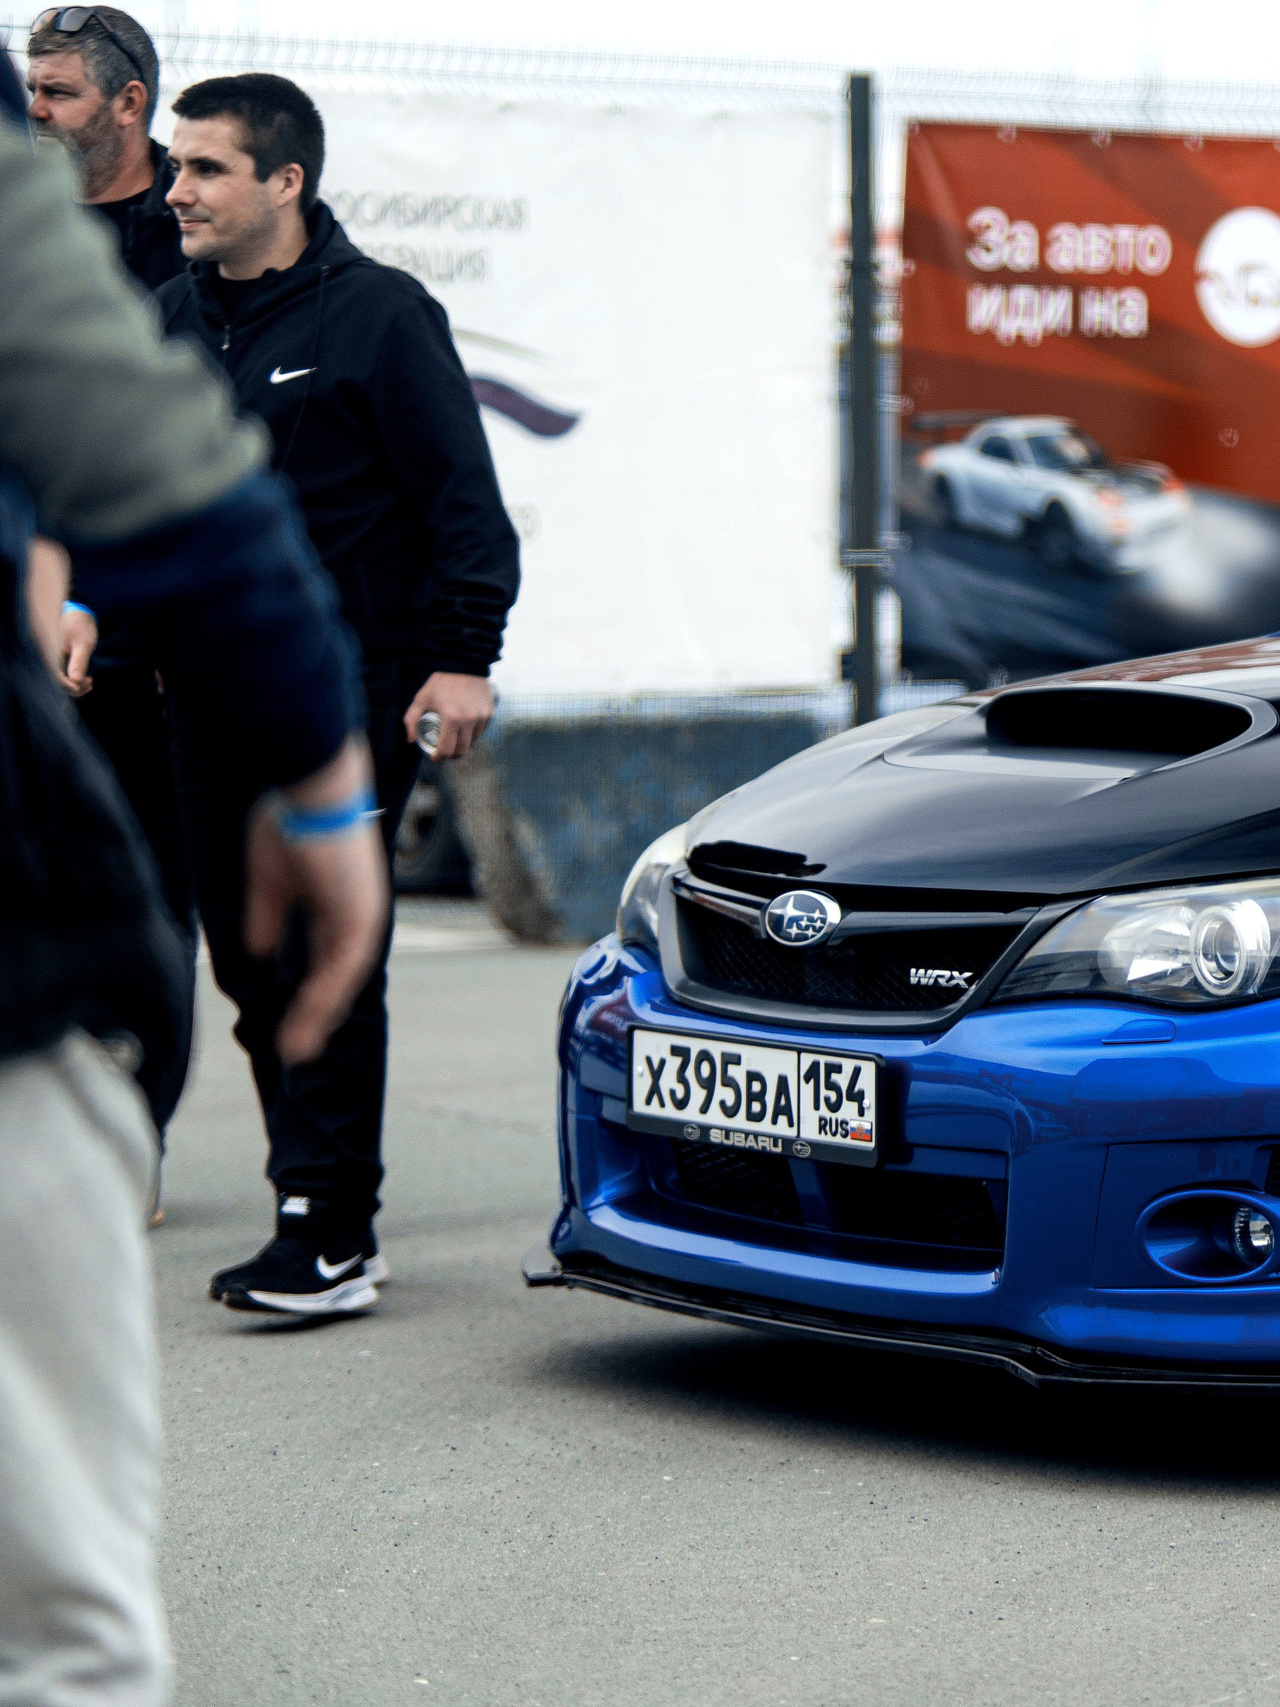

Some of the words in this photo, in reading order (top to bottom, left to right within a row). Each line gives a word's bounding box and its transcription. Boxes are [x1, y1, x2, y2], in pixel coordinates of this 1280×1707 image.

[966, 206, 1040, 272] За
[1045, 221, 1173, 276] авто
[966, 283, 1074, 347] иди
[1079, 286, 1149, 338] на
[910, 968, 974, 988] WRX
[645, 1044, 794, 1128] Х395ВА
[803, 1059, 866, 1117] 154
[709, 1128, 782, 1153] SUBARU
[818, 1116, 849, 1139] RUS
